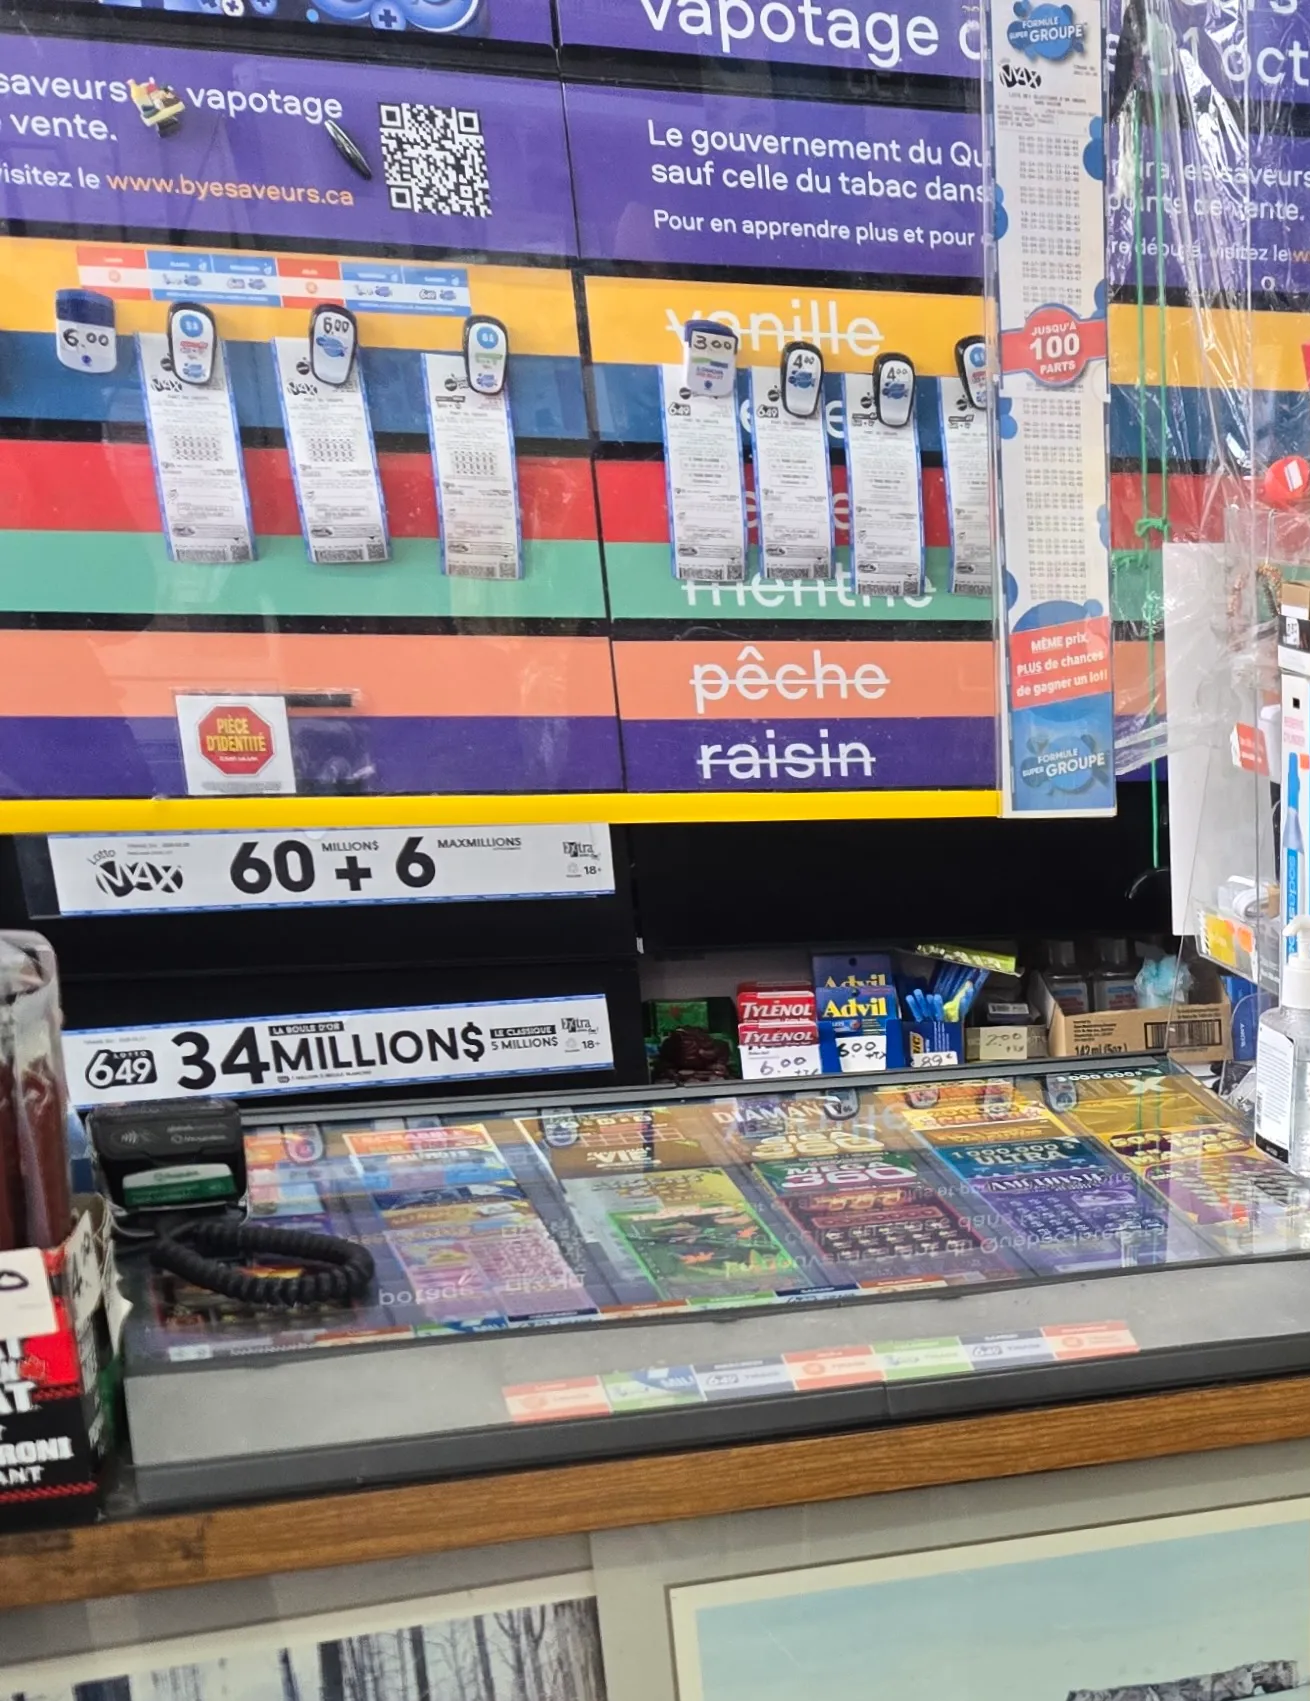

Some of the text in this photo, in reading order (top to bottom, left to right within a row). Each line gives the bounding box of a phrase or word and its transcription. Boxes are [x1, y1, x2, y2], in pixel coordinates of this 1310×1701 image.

[1030, 25, 1083, 42] GROUPE
[187, 86, 343, 125] vapotage
[10, 113, 118, 141] vente.
[648, 120, 943, 165] Le gouvernement du
[78, 167, 100, 189] le
[106, 173, 354, 206] www.byesaveurs.ca
[652, 161, 714, 185] sauf
[722, 165, 789, 191] celle
[797, 169, 831, 193] du
[837, 171, 917, 199] tabac
[654, 209, 974, 249] Pour en apprendre plus et pour
[1030, 333, 1079, 361] 100
[1040, 360, 1075, 375] PARTS
[1017, 650, 1105, 676] PLUS de chances
[690, 646, 889, 713] pêche
[1017, 685, 1031, 697] de
[1033, 679, 1071, 697] gagner
[1074, 674, 1088, 686] un
[216, 715, 249, 734] PIÈCE
[697, 729, 876, 779] raisin
[1046, 753, 1106, 777] GROUPE
[438, 837, 521, 849] MAXMILLIONS
[230, 839, 315, 894] 60
[335, 856, 372, 891] +
[396, 837, 436, 888] 6
[741, 1001, 813, 1019] TYLENOL
[823, 997, 888, 1018] Advil
[741, 1031, 813, 1043] TYLENOL
[171, 1022, 485, 1090] 34 MILLION$
